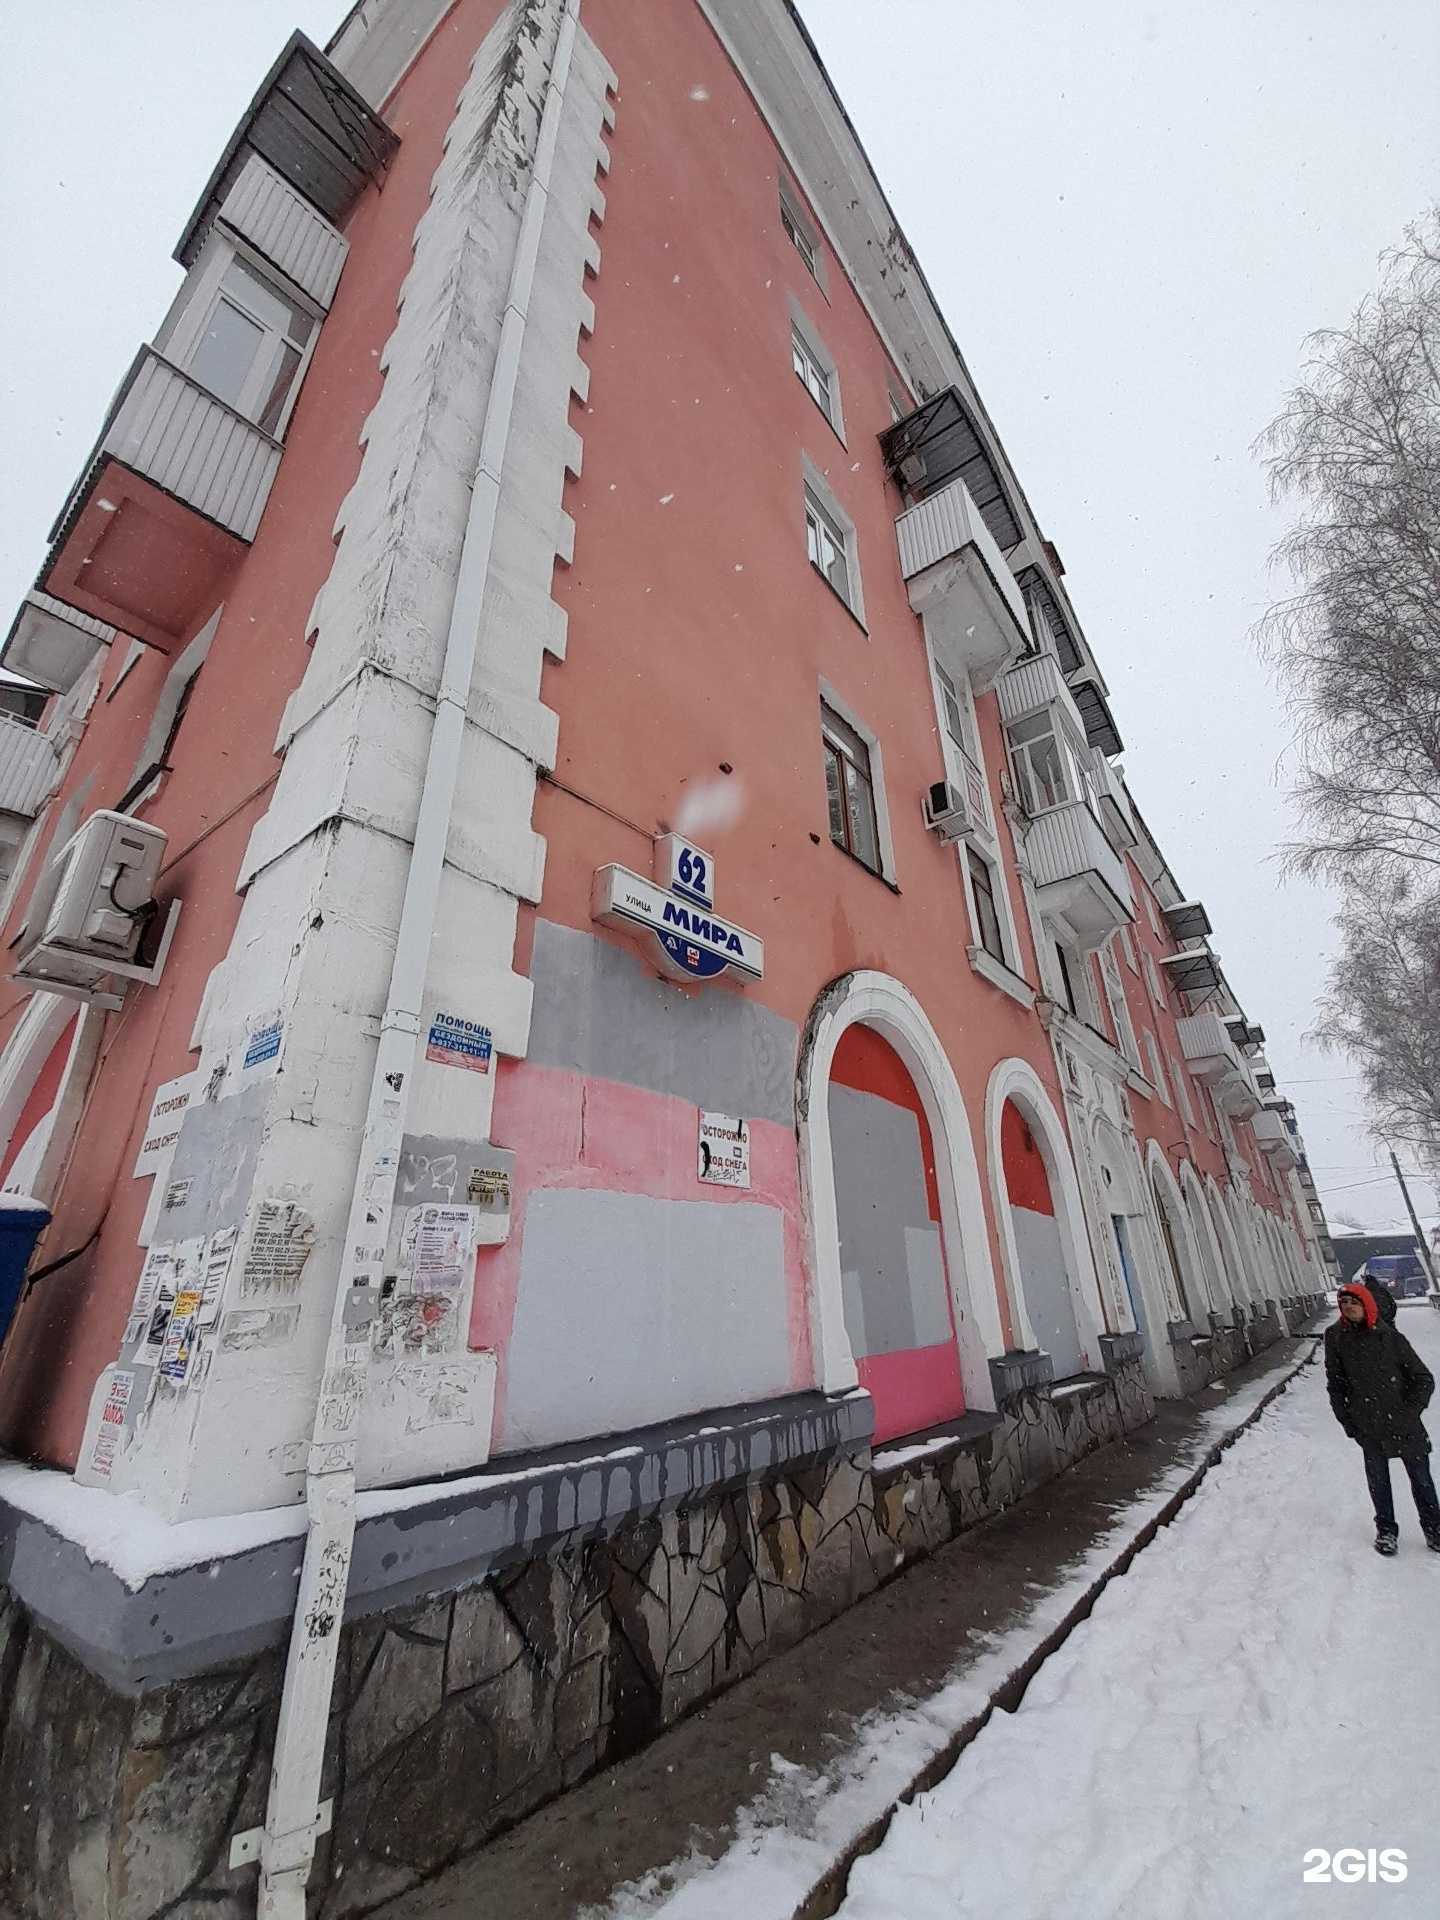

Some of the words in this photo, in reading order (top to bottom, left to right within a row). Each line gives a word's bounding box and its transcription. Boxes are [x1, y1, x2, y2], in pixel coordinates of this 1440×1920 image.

[678, 847, 706, 894] 62
[625, 894, 652, 913] УЛИЦА
[662, 901, 744, 956] МИРА
[436, 1013, 492, 1036] ПОМОЩЬ
[702, 1125, 748, 1144] ОСТОРОЖНО
[724, 1158, 747, 1170] СНЕГА
